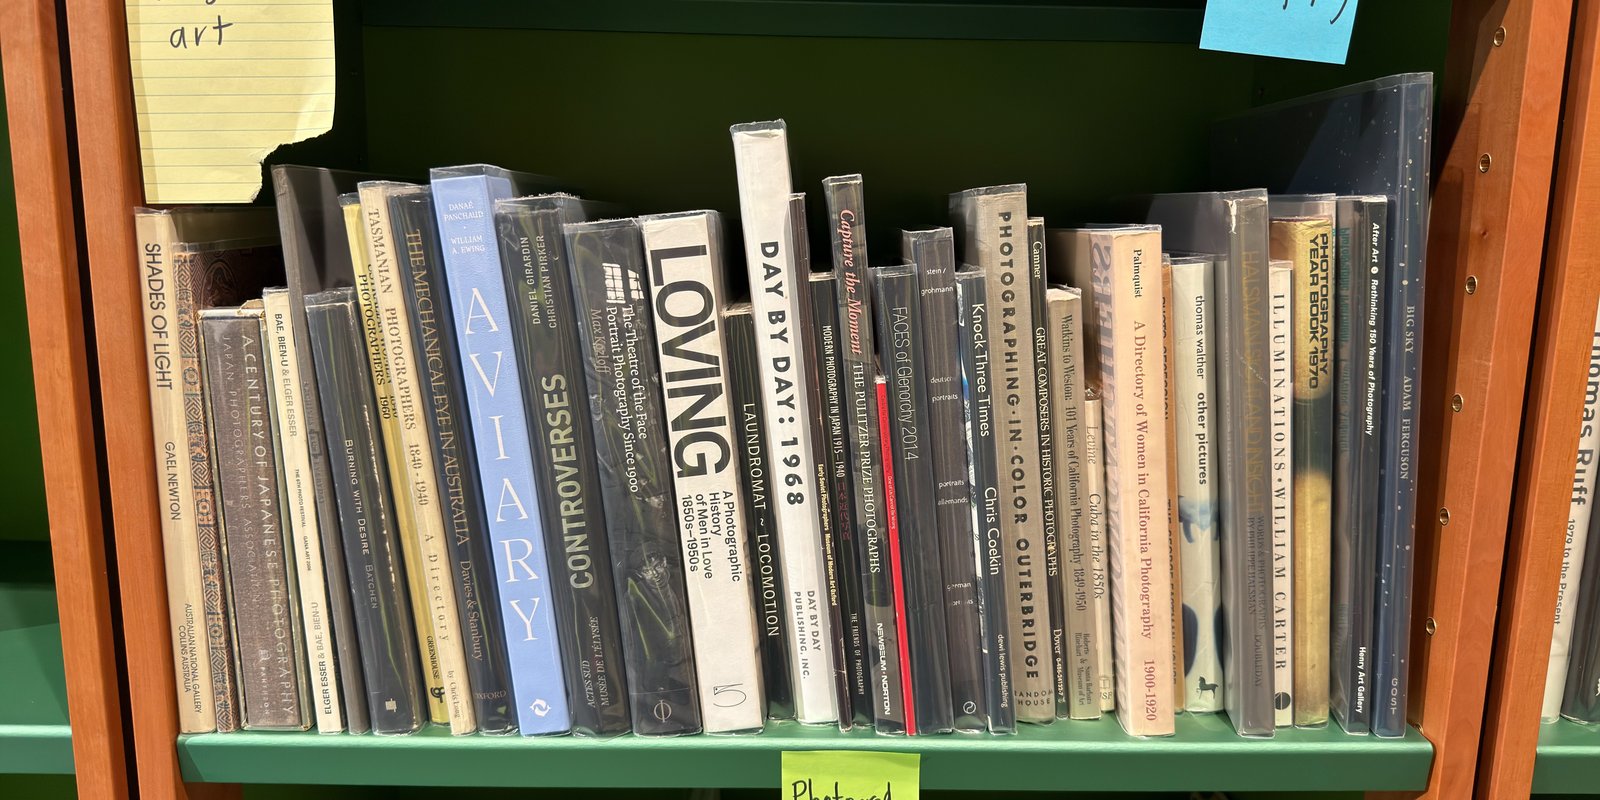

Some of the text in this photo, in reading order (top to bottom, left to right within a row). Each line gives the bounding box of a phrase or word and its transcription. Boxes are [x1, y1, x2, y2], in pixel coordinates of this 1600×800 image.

[170, 15, 233, 49] art
[443, 211, 484, 222] PANCHAUD
[451, 235, 483, 245] WILLIAM
[1033, 241, 1043, 279] Camner
[145, 243, 173, 390] SHADES OF LIGHT
[520, 237, 541, 325] DANIEL GIRARDIN
[536, 235, 557, 329] CHRISTIAN PIRKER
[837, 209, 862, 355] Capture the Moment
[921, 286, 953, 297] grohmann
[1133, 249, 1143, 298] Palmquist
[1309, 234, 1319, 389] YEAR BOOK 1970
[1319, 233, 1329, 374] PHOTOGRAPHY
[274, 313, 285, 333] BAE,
[277, 336, 289, 366] BIEN-U
[359, 274, 385, 386] PHOTOGRAPHERS
[590, 309, 611, 375] Max Kozloff
[650, 245, 731, 478] LOVING
[1365, 222, 1380, 436] After Art Rethinking 150 Years of Photography
[283, 377, 294, 407] ELGER
[380, 396, 391, 419] 1960
[405, 229, 470, 546] THE MECHANICAL EYE IN AUSTRALIA
[606, 306, 638, 493] Portrait Photography Since 1900
[622, 304, 647, 440] The Theatre of the Face
[761, 241, 805, 505] DAY BY DAY: 1968
[892, 307, 919, 461] FACES of Glenorchy 2014
[932, 394, 958, 403] portraits
[972, 303, 991, 437] Knock Three Times
[1195, 295, 1208, 485] thomas walther other pictures
[1400, 306, 1415, 483] BIG SKY ADAM FERGUSON
[287, 408, 297, 437] ESSER
[465, 288, 540, 642] AVIARY
[1035, 327, 1057, 577] GREAT COMPOSERS IN HISTORIC PHOTOGRAPHS
[1061, 314, 1087, 611] Watkins to Weston: 101 Years of California Photography 1849-1950
[1086, 426, 1098, 464] Levine
[165, 441, 181, 520] GAEL NEWTON
[541, 374, 594, 589] CONTROVERSES
[853, 362, 881, 573] THE PULITZER PRIZE PHOTOGRAPHS
[938, 479, 964, 489] portraits
[242, 335, 294, 714] A CENTURY OF JAPANESE PHOTOGRAPHY
[345, 439, 378, 610] BURNING WITH DESIRE BATCHEN
[696, 494, 713, 579] of Men in Love
[709, 492, 721, 536] History
[723, 490, 742, 582] A Photographic
[984, 487, 1001, 576] Chris Coekin
[1088, 493, 1105, 600] Cuba in the 1850s
[1133, 321, 1157, 721] A Directory of Women in California Photography 1900-1920
[311, 602, 322, 630] BIEN-U
[425, 534, 448, 641] A Directory
[460, 560, 483, 661] Davies & Stanbury
[807, 590, 822, 651] DAY BY DAY
[179, 625, 191, 692] COLLINS AUSTRALIA
[315, 632, 324, 653] BAE,
[318, 661, 329, 689] ESSER
[794, 591, 810, 680] PUBLISHING, INC.
[997, 634, 1005, 652] dewi
[1254, 633, 1263, 688] DOUBLEDAY
[1355, 646, 1367, 713] Henry Art Gallery
[321, 689, 333, 714] ELGER
[1000, 672, 1009, 708] publishing
[1017, 698, 1050, 706] HOUSE
[1390, 678, 1399, 715] GOST
